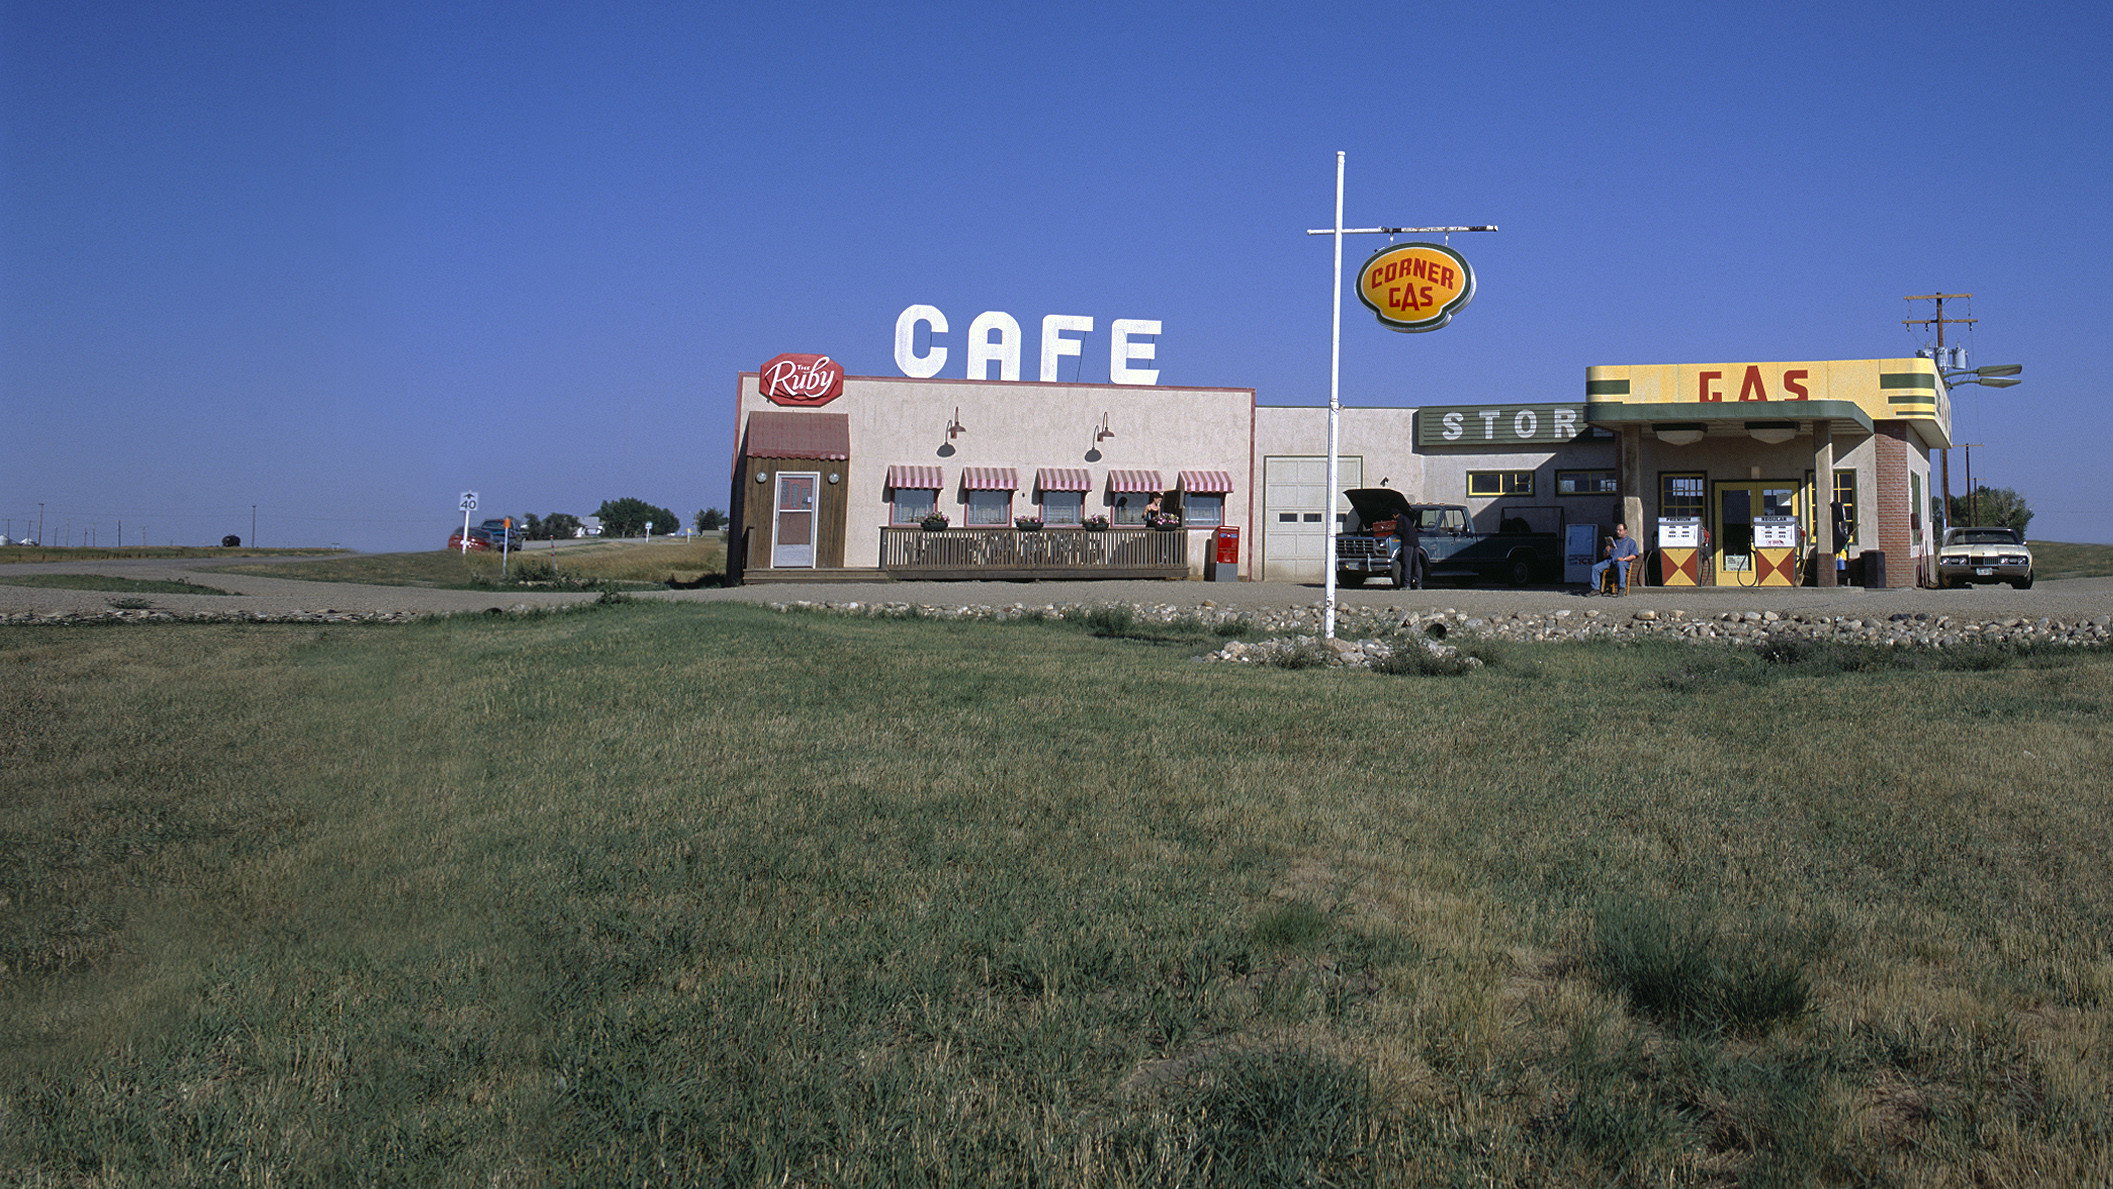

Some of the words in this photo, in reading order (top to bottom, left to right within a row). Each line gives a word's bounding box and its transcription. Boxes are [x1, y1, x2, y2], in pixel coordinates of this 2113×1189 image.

[1371, 258, 1455, 290] CORNER
[1388, 282, 1433, 311] GAS
[894, 304, 1162, 386] CAFE
[765, 356, 835, 398] Ruby
[1698, 364, 1809, 403] GAS
[460, 500, 477, 510] 40
